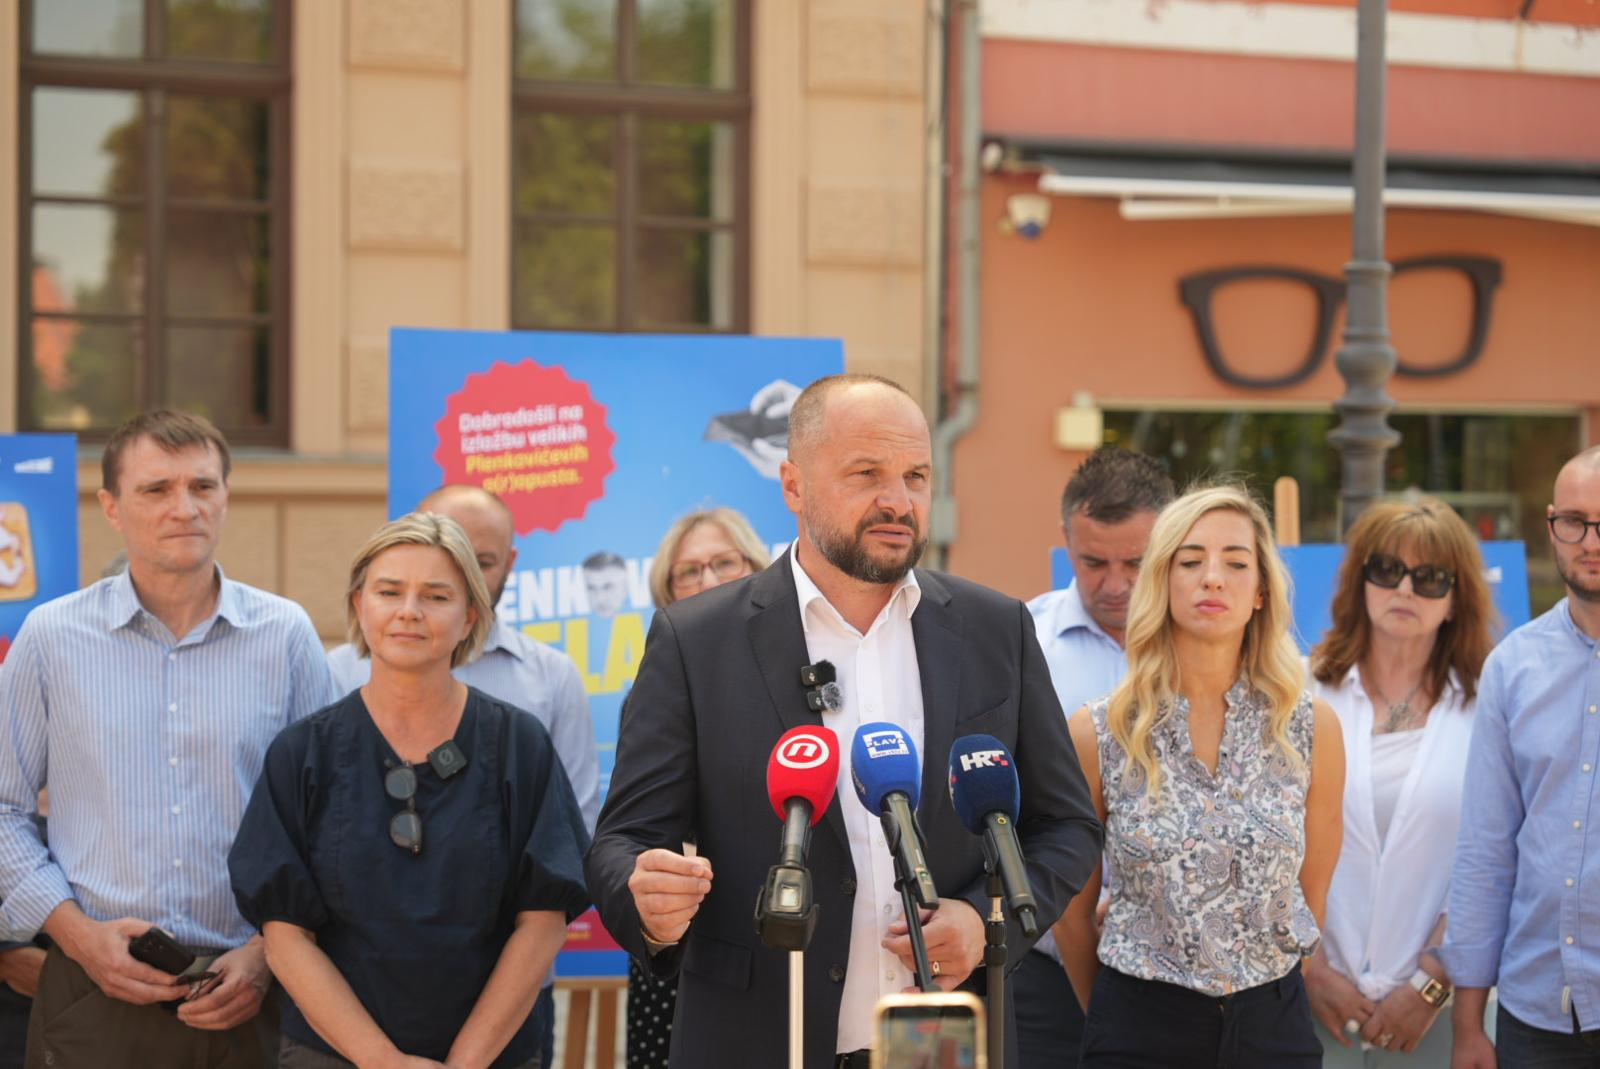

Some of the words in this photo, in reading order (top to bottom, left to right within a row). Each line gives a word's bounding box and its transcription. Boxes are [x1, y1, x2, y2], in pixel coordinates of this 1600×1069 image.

[459, 404, 556, 433] Dobrodošli
[558, 404, 584, 421] na
[527, 423, 588, 447] velikih
[960, 750, 1008, 772] HRT
